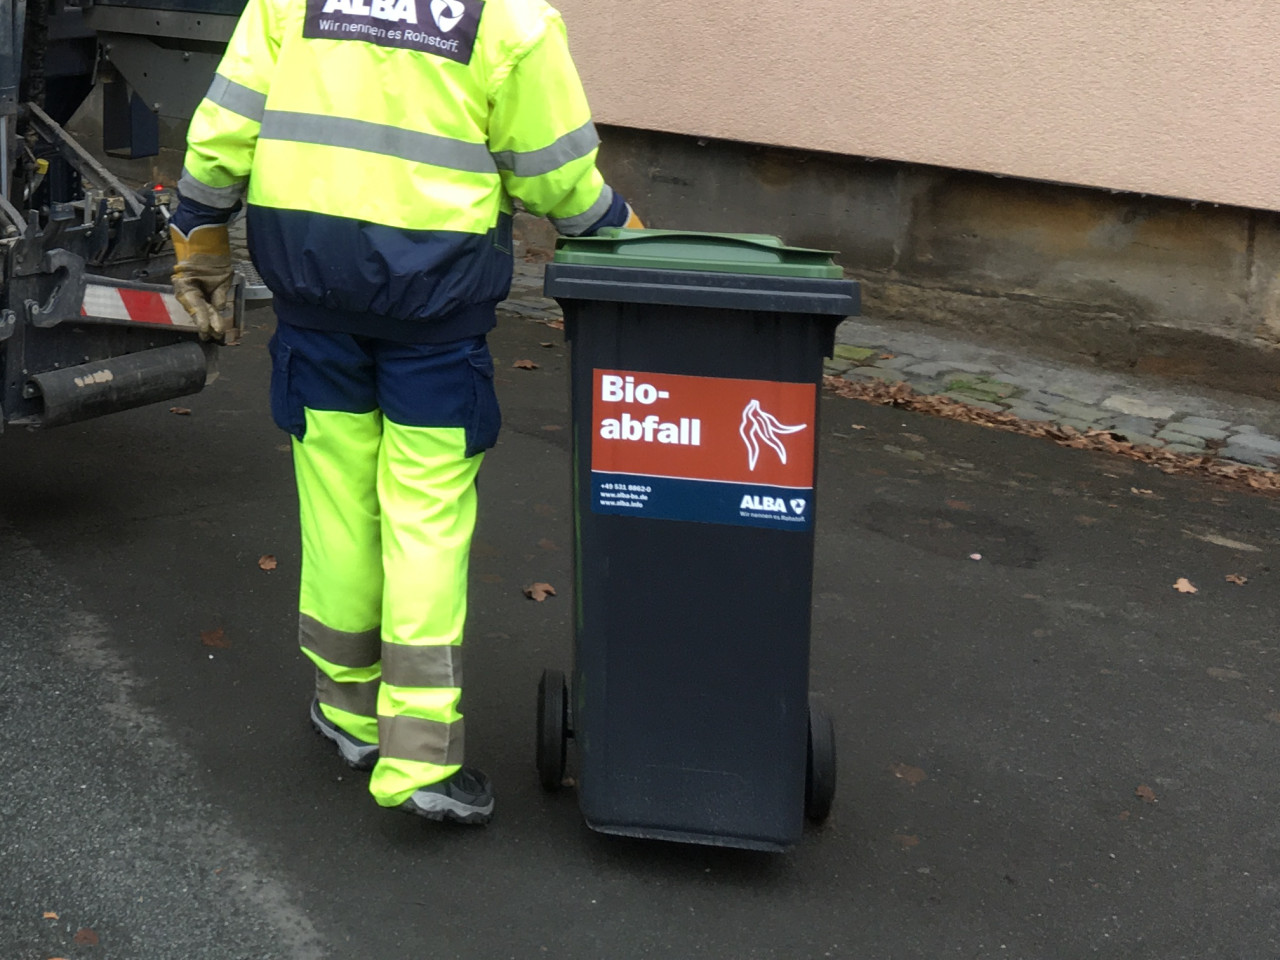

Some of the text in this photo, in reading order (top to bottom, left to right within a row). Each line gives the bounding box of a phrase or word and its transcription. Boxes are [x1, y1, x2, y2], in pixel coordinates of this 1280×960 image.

[319, 19, 459, 53] Wir nennen es Rohstoff.
[601, 374, 670, 405] Bio-
[600, 413, 701, 446] abfall
[740, 494, 788, 514] ALBA
